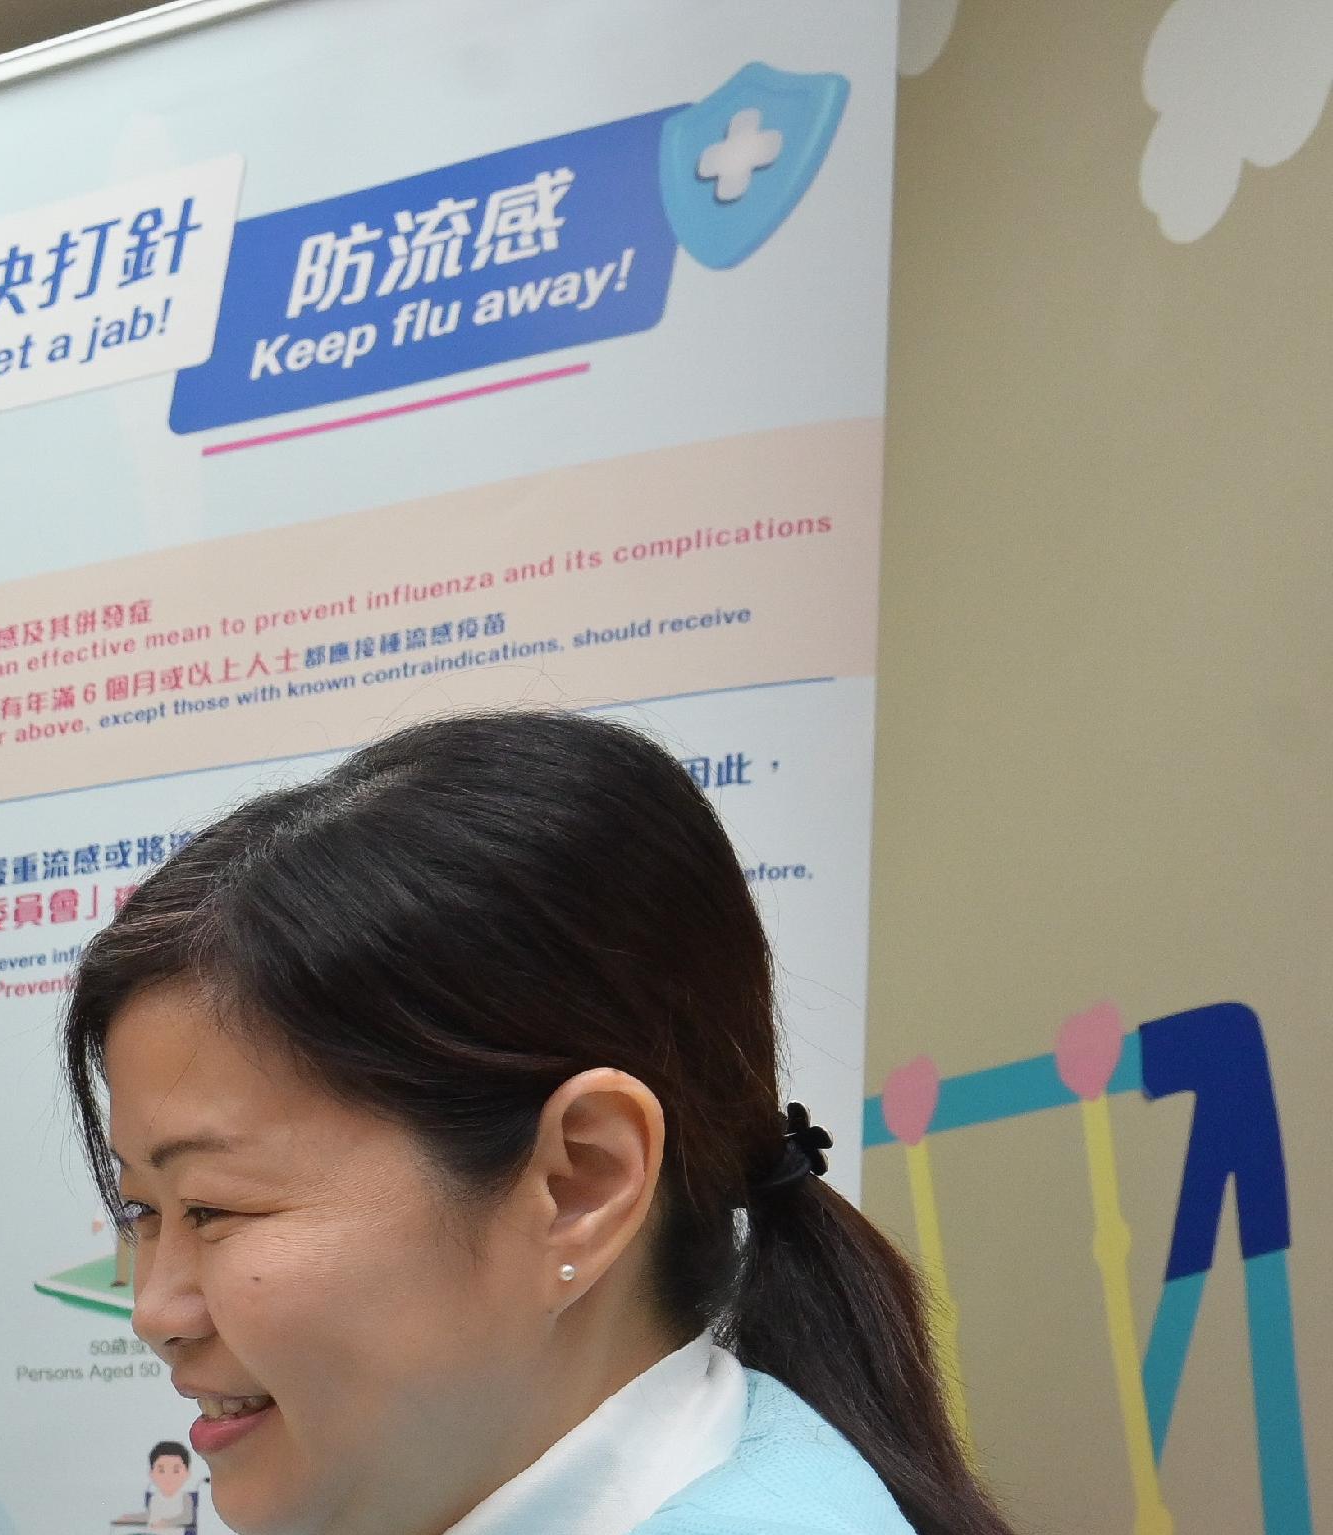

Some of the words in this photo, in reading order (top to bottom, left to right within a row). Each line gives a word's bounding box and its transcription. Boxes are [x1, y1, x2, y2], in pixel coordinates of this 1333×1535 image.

[285, 166, 577, 320] 防流感
[45, 336, 73, 364] a
[78, 298, 173, 365] jab!
[249, 319, 377, 382] Keep
[391, 294, 460, 350] flu
[473, 248, 636, 329] away!
[27, 636, 137, 672] effective
[145, 624, 211, 649] mean
[221, 616, 246, 636] to
[254, 595, 357, 636] prevent
[367, 570, 495, 611] influenza
[504, 555, 555, 584] and
[565, 548, 604, 573] its
[613, 514, 834, 565] complications
[14, 716, 91, 744] above,
[99, 702, 166, 730] except
[173, 696, 230, 716] those
[236, 684, 281, 706] with
[287, 674, 356, 698] known
[572, 618, 652, 649] should
[658, 607, 752, 635] receive
[82, 682, 97, 705] 6
[52, 943, 83, 964] infl
[744, 862, 815, 882] efore.
[15, 1364, 84, 1382] Persons
[89, 1363, 134, 1382] Aged
[140, 1360, 161, 1378] 50
